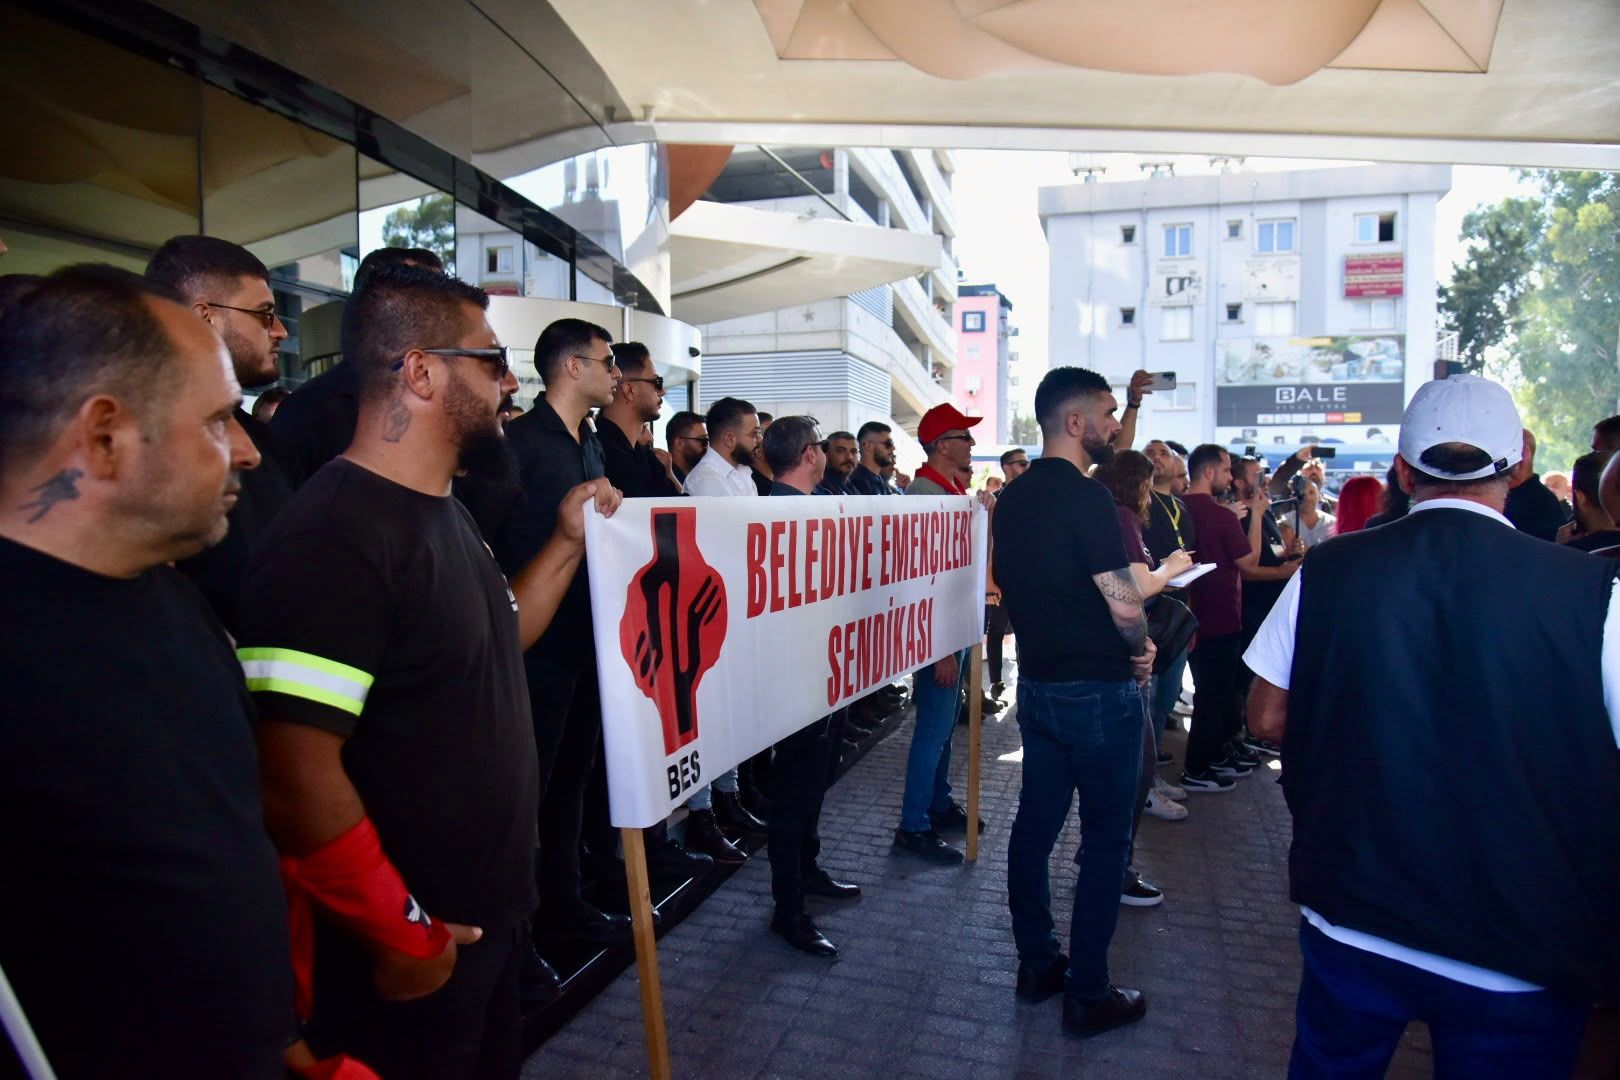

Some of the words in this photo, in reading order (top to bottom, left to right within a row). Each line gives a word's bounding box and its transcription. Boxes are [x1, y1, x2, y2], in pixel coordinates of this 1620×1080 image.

[1276, 386, 1347, 404] BALE
[747, 502, 874, 619] BELEDİYE
[880, 499, 973, 587] EMEKÇİLERİ
[827, 596, 935, 708] SENDİKASI
[666, 750, 701, 801] BES
